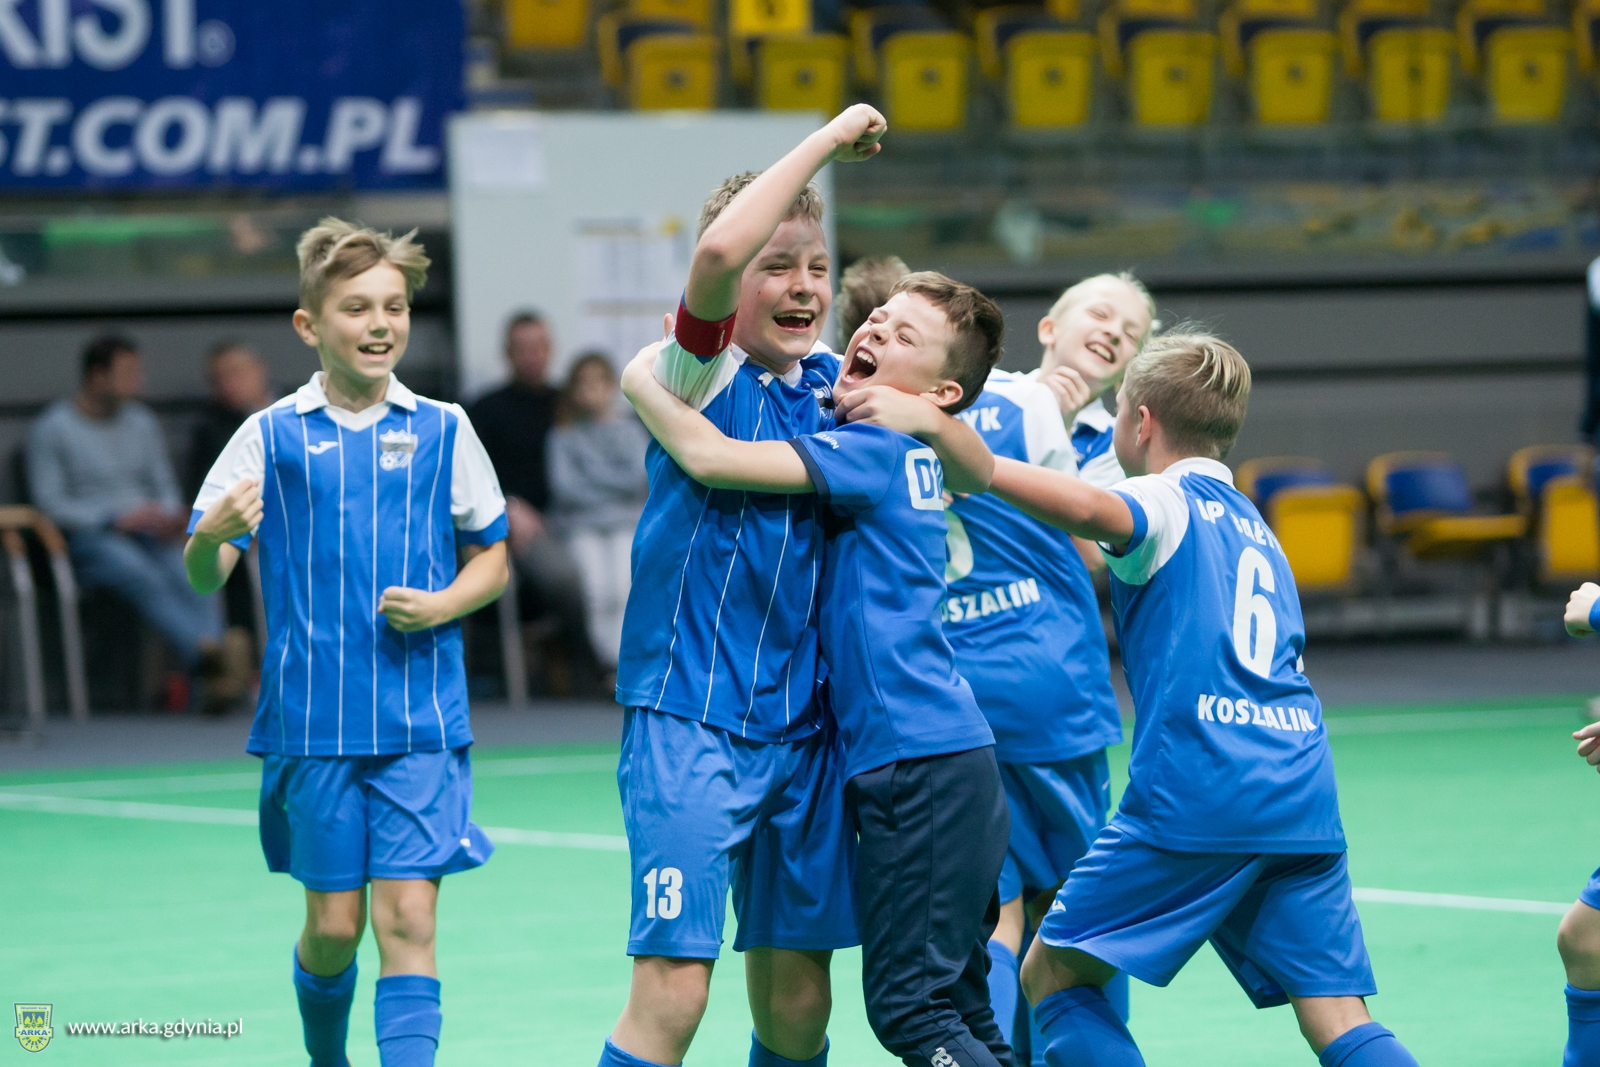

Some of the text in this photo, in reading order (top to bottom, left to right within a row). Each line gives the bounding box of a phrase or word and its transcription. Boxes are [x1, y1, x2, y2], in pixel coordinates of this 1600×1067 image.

[0, 97, 437, 176] T.COM.PL
[953, 406, 1002, 432] YK
[1233, 546, 1277, 679] 6
[1198, 693, 1317, 732] KOSZALIN
[643, 867, 683, 919] 13
